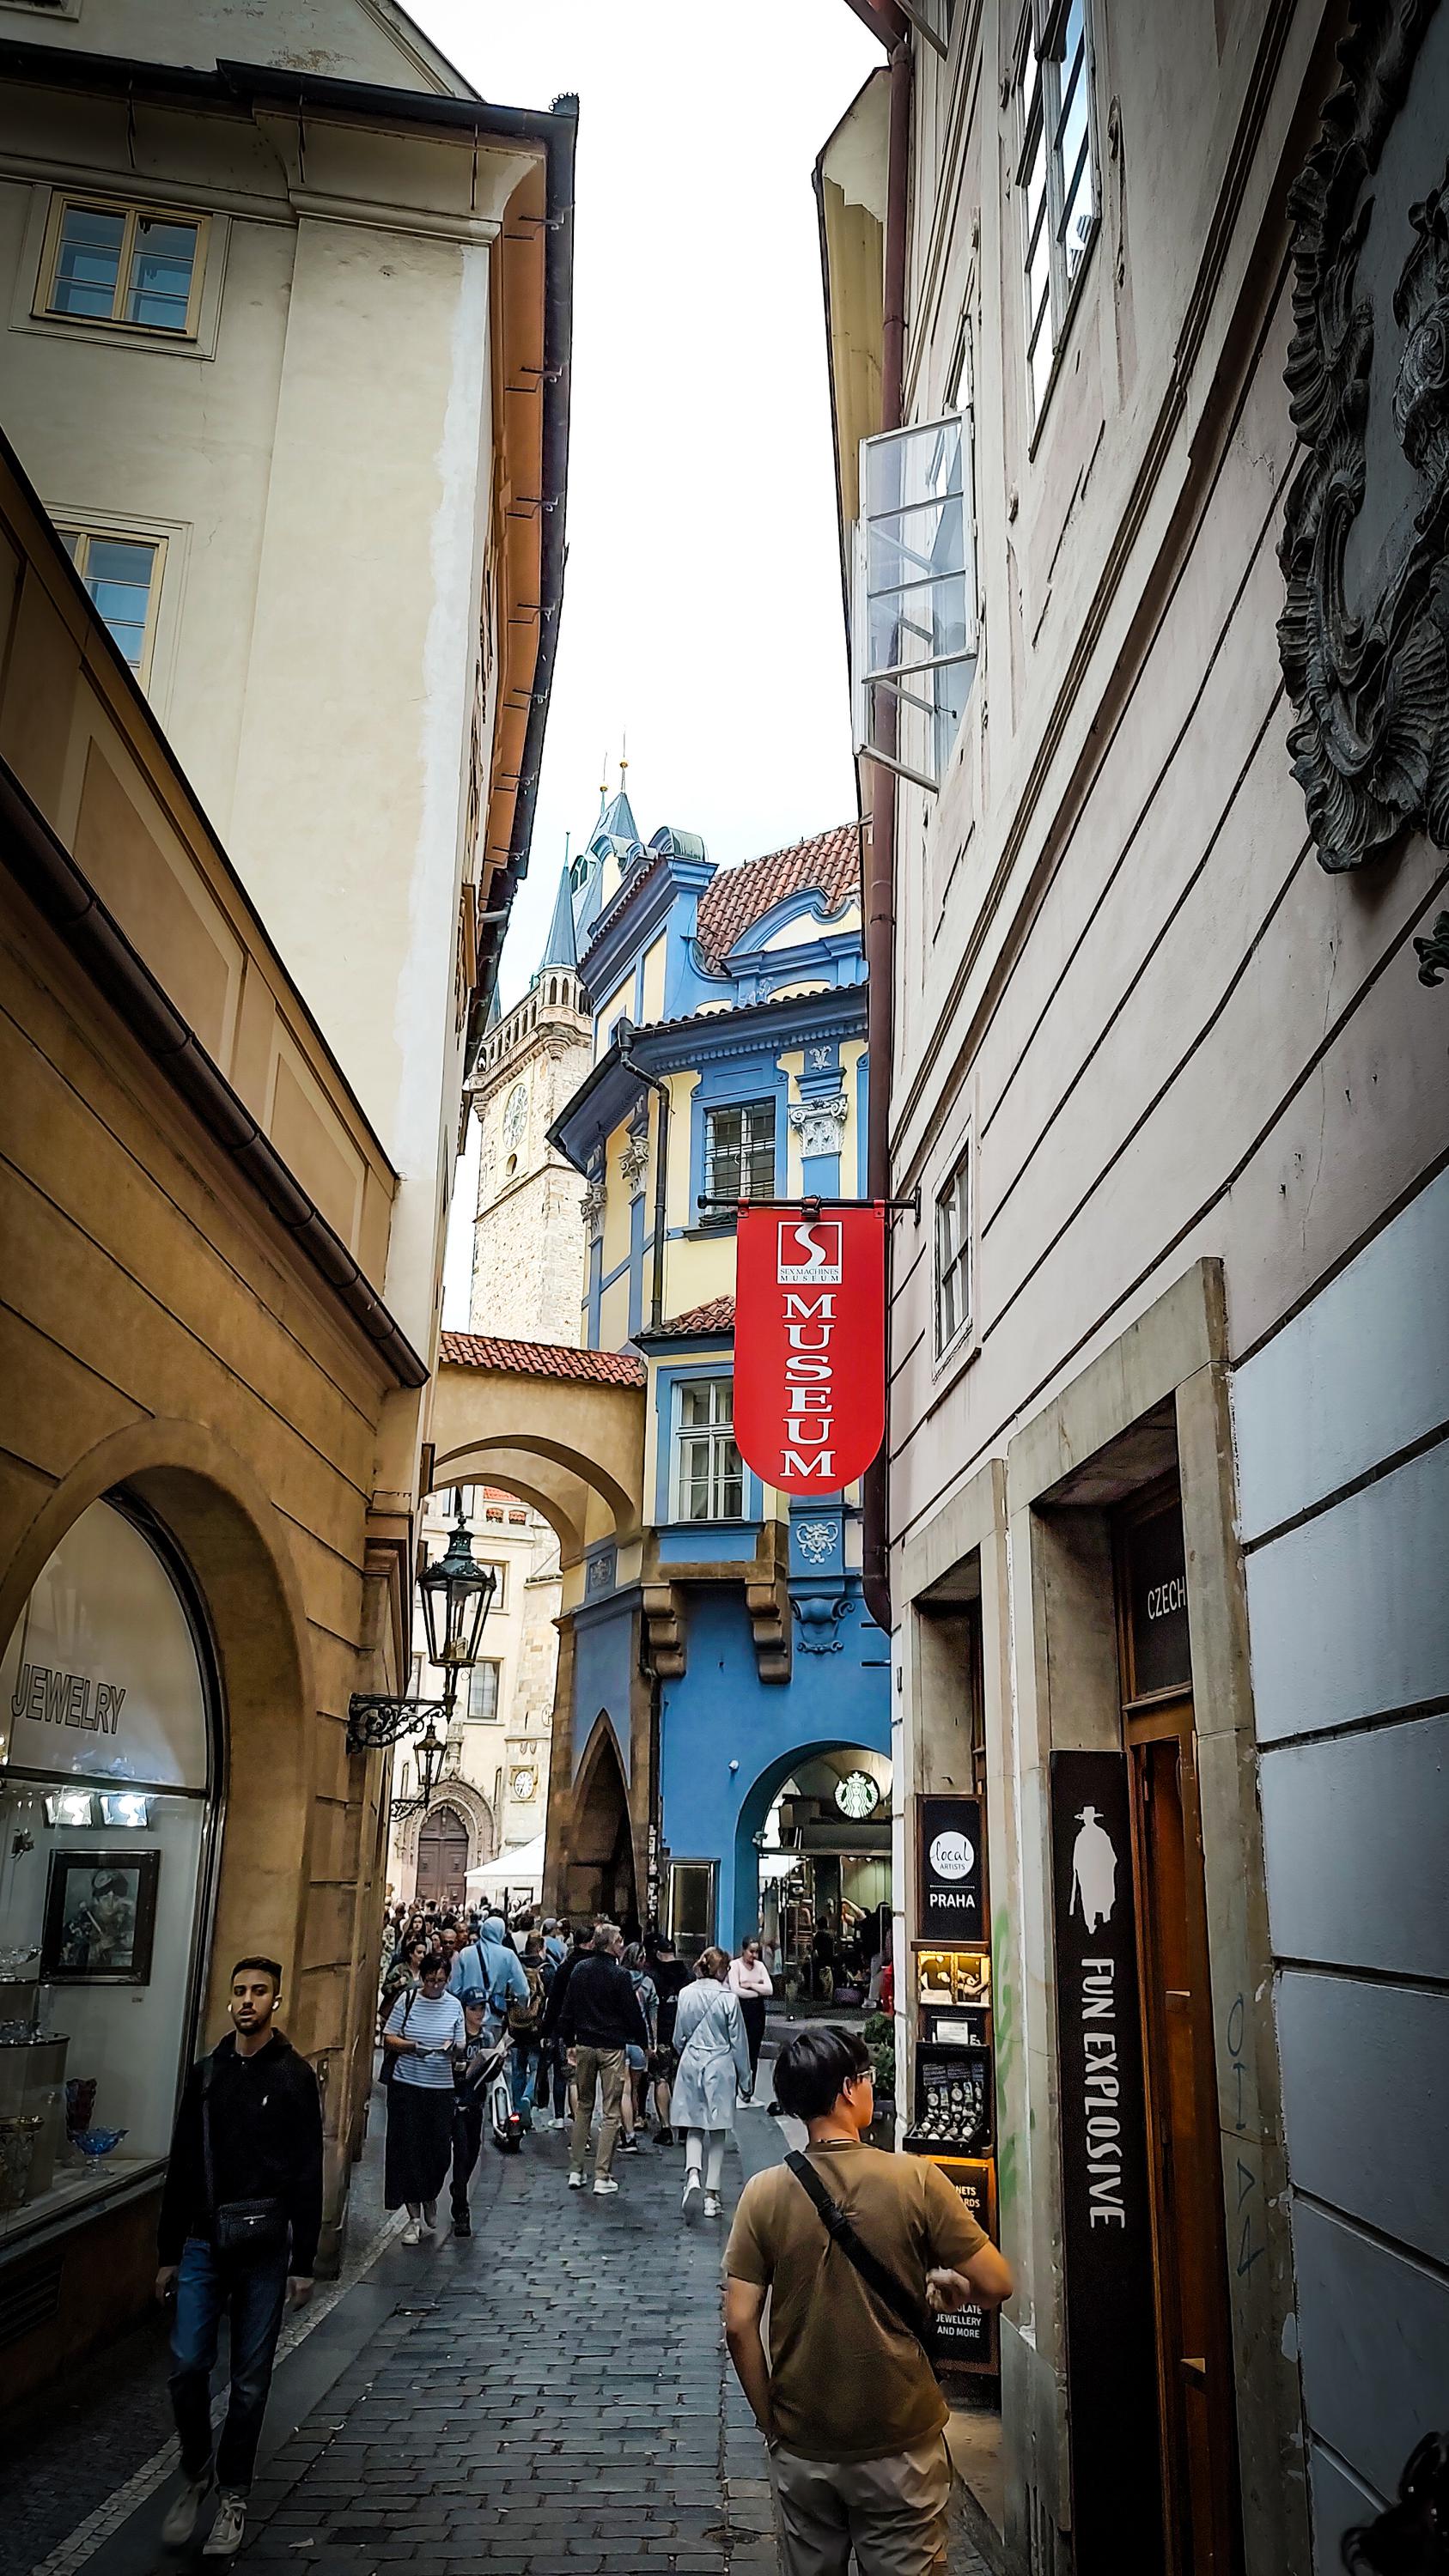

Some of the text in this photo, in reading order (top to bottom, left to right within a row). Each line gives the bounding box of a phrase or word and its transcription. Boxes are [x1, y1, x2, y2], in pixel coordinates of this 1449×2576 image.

[779, 1293, 837, 1478] MUSEUM
[1148, 1576, 1186, 1620] CZECH
[11, 1663, 126, 1735] JEWELRY
[931, 1841, 972, 1862] local
[929, 1893, 976, 1908] PRAHA
[1081, 1958, 1126, 2229] FUN EXPLOSIVE
[955, 2185, 977, 2196] NETS
[935, 2313, 982, 2326] JEWELLERY
[936, 2324, 980, 2338] AND MORE
